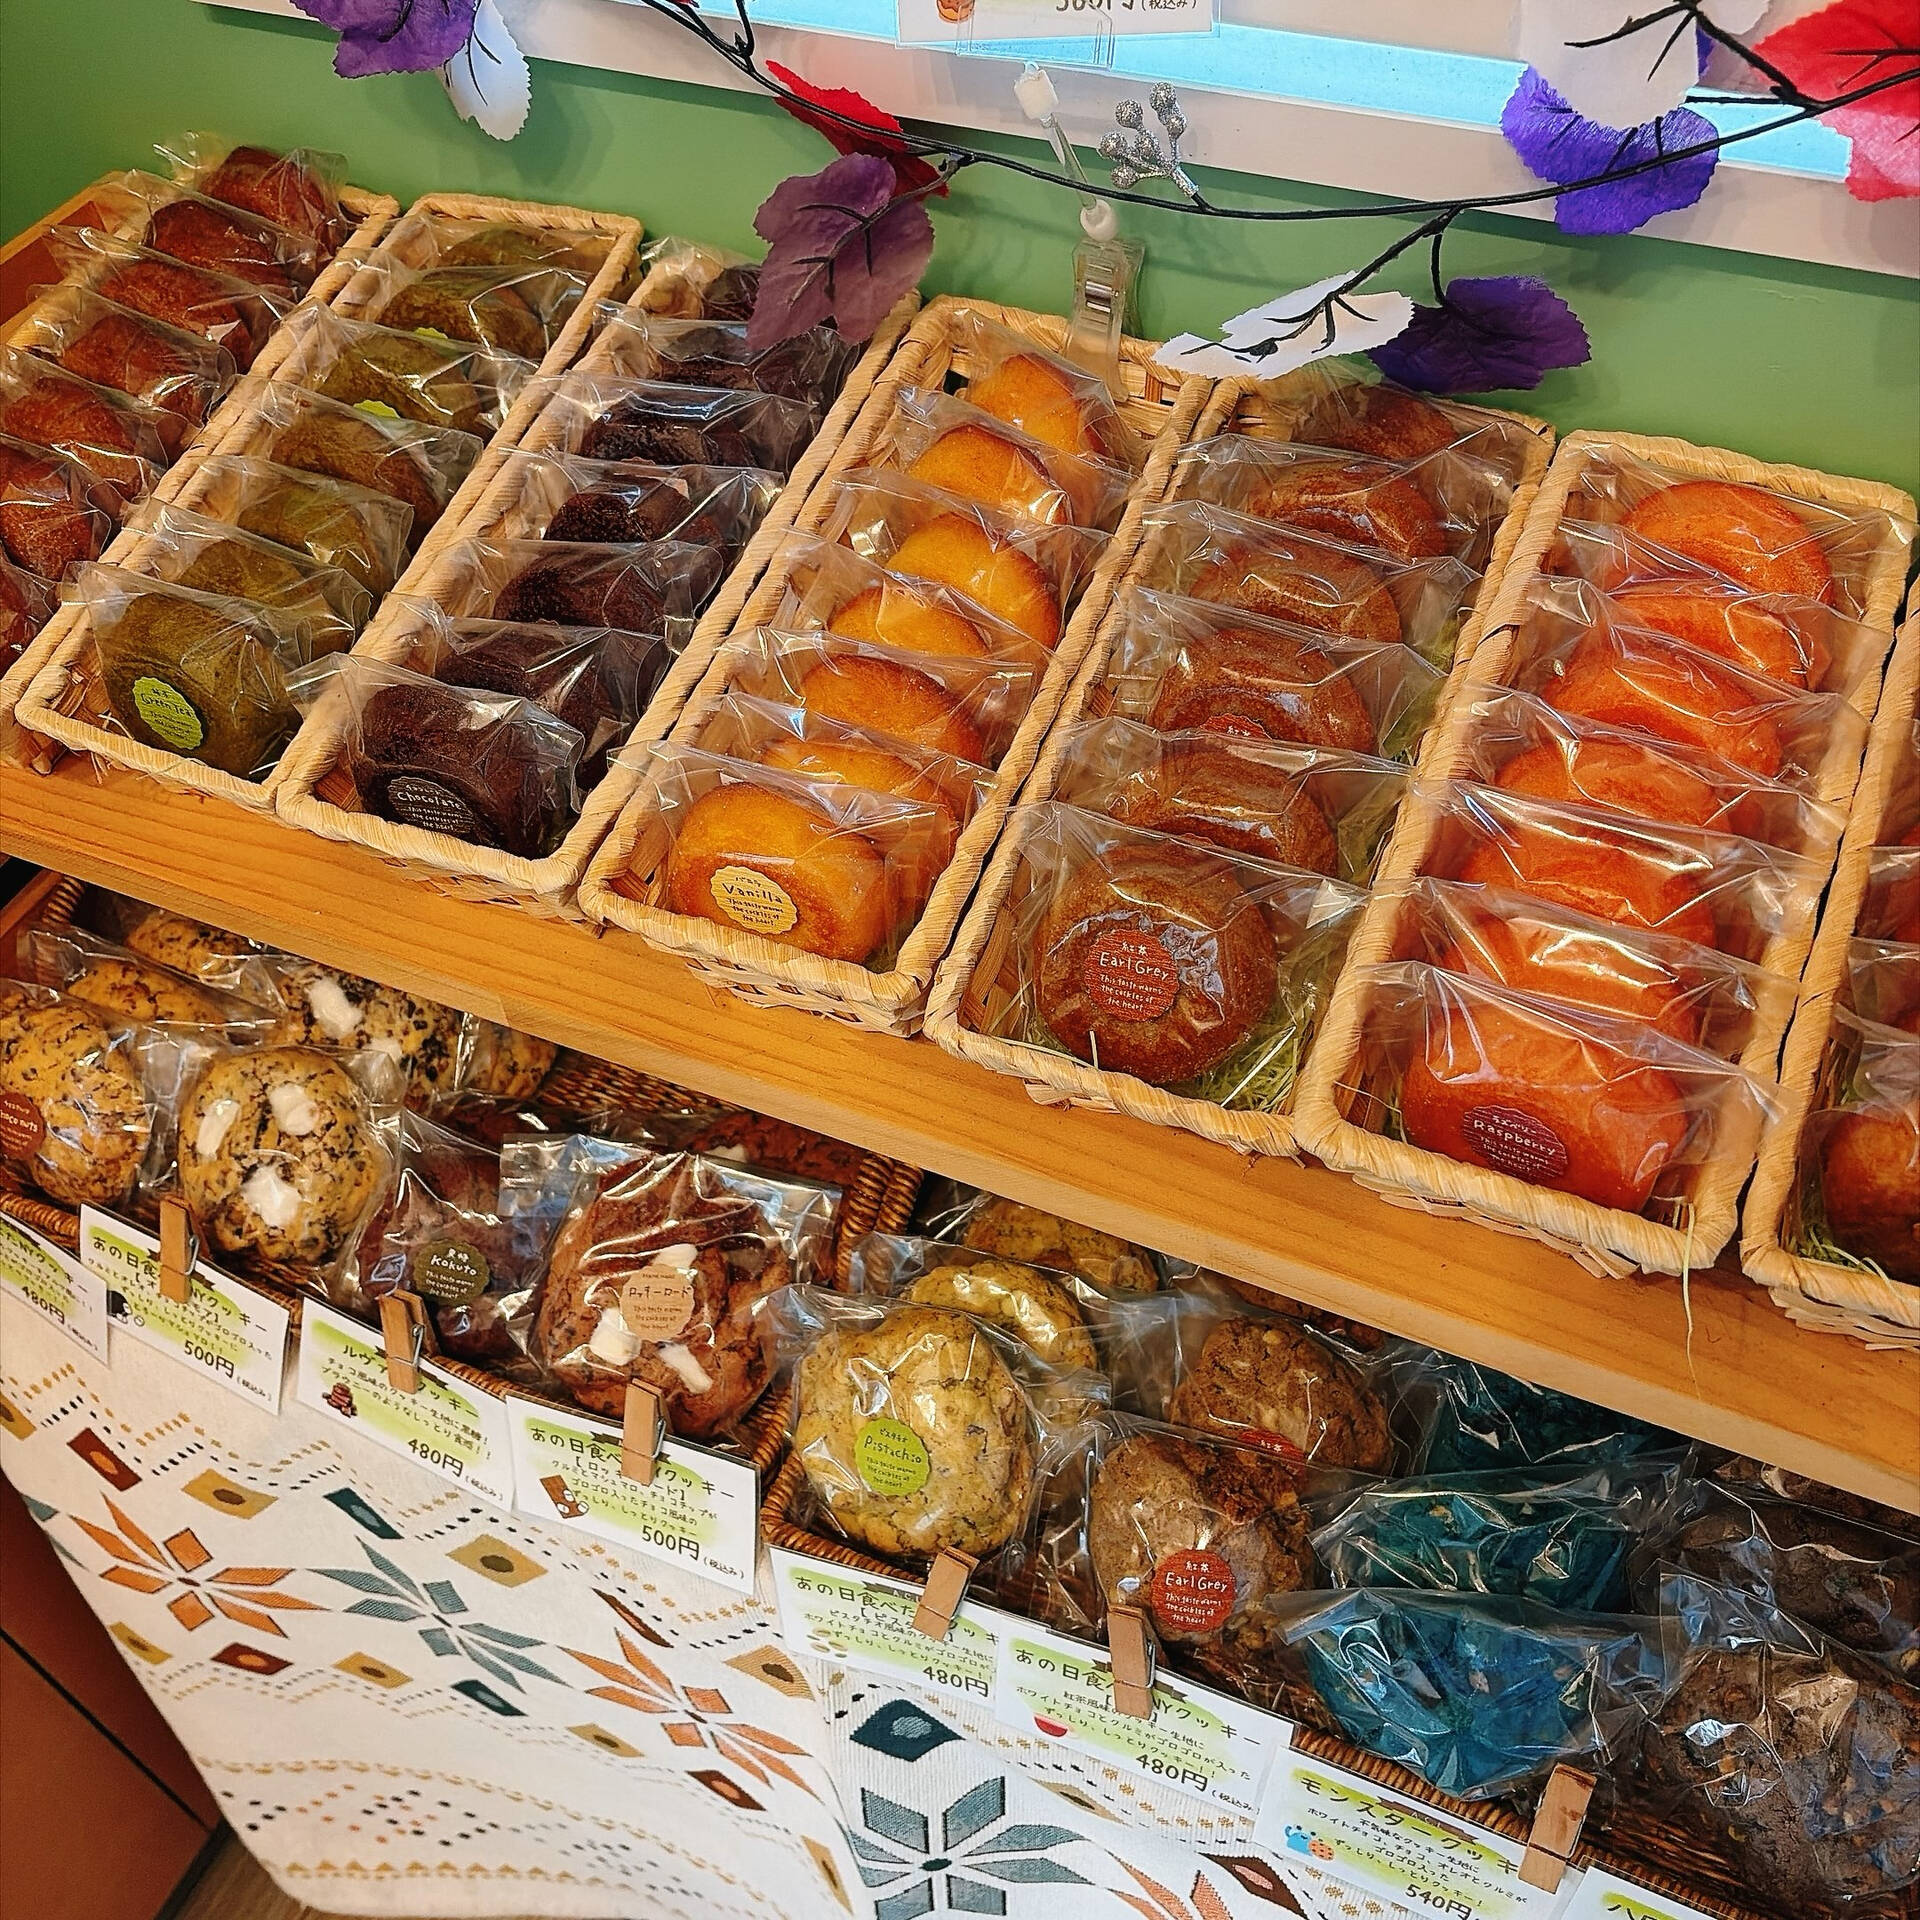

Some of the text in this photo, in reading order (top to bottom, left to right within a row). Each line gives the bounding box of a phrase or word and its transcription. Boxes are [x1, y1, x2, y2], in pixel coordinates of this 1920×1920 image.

[140, 694, 192, 718] Green Tea
[397, 791, 462, 811] Chocolate
[722, 883, 783, 904] Vanilla
[1100, 951, 1169, 980] Earl Grey
[1122, 941, 1148, 956] 紅茶
[0, 1110, 18, 1125] hoco
[1492, 1115, 1536, 1134] ラズベリー
[1474, 1119, 1555, 1155] Raspberry
[430, 1254, 477, 1275] Kokuto
[93, 1236, 268, 1332] あの日食NYクッキー
[22, 1285, 65, 1325] 480円
[184, 1339, 235, 1379] 500円
[343, 1345, 479, 1419] ルヴァクッキー
[864, 1435, 922, 1464] Pistachio
[880, 1428, 908, 1443] ピスタチオ
[407, 1438, 464, 1478] 480円
[530, 1427, 735, 1500] あの日食べYクッキー
[576, 1457, 685, 1502] 【ロッキード】
[641, 1525, 700, 1562] 500円
[1165, 1572, 1227, 1592] Earl Grey
[1186, 1561, 1209, 1572] 紅茶
[794, 1576, 999, 1646] あの日食べたクッキ
[860, 1607, 953, 1643] 【ピスタ】
[923, 1666, 989, 1698] 480円
[1015, 1648, 1261, 1746] あの日食NYクッキー
[1136, 1753, 1208, 1793] 480円
[1300, 1776, 1519, 1874] モンスタークッキ
[1374, 1845, 1449, 1882] ゴロゴロ入った
[1405, 1883, 1473, 1920] 540円
